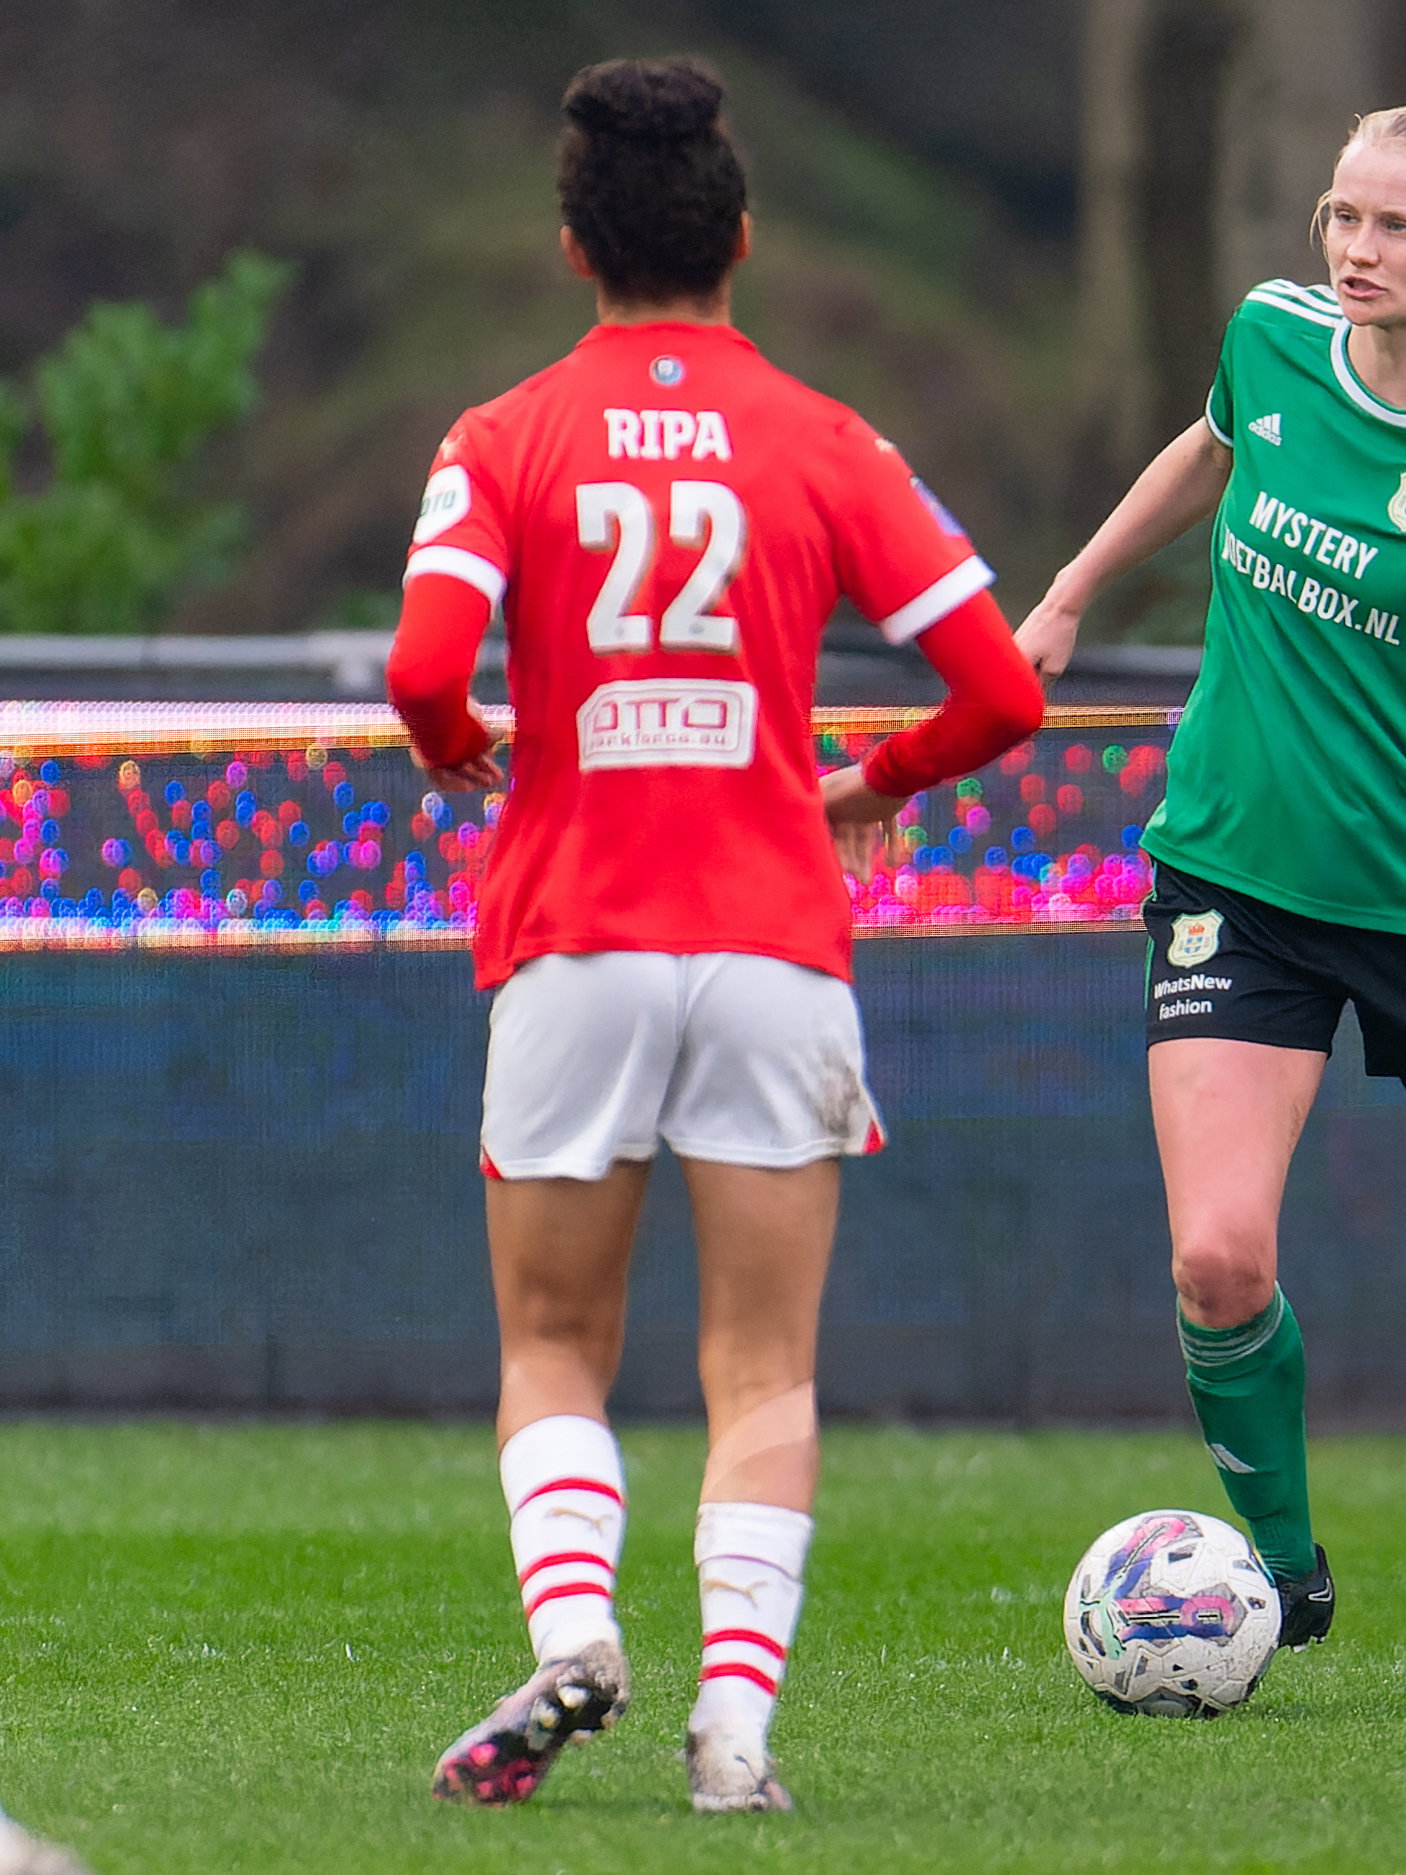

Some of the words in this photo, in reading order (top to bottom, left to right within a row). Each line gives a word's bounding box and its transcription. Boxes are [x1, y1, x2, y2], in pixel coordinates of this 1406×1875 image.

[603, 408, 732, 463] RIPA
[1249, 491, 1378, 580] MYSTERY
[575, 480, 749, 655] 22
[593, 697, 728, 733] OTTO
[1154, 973, 1233, 1000] WhatsNew
[1159, 998, 1213, 1021] fashion
